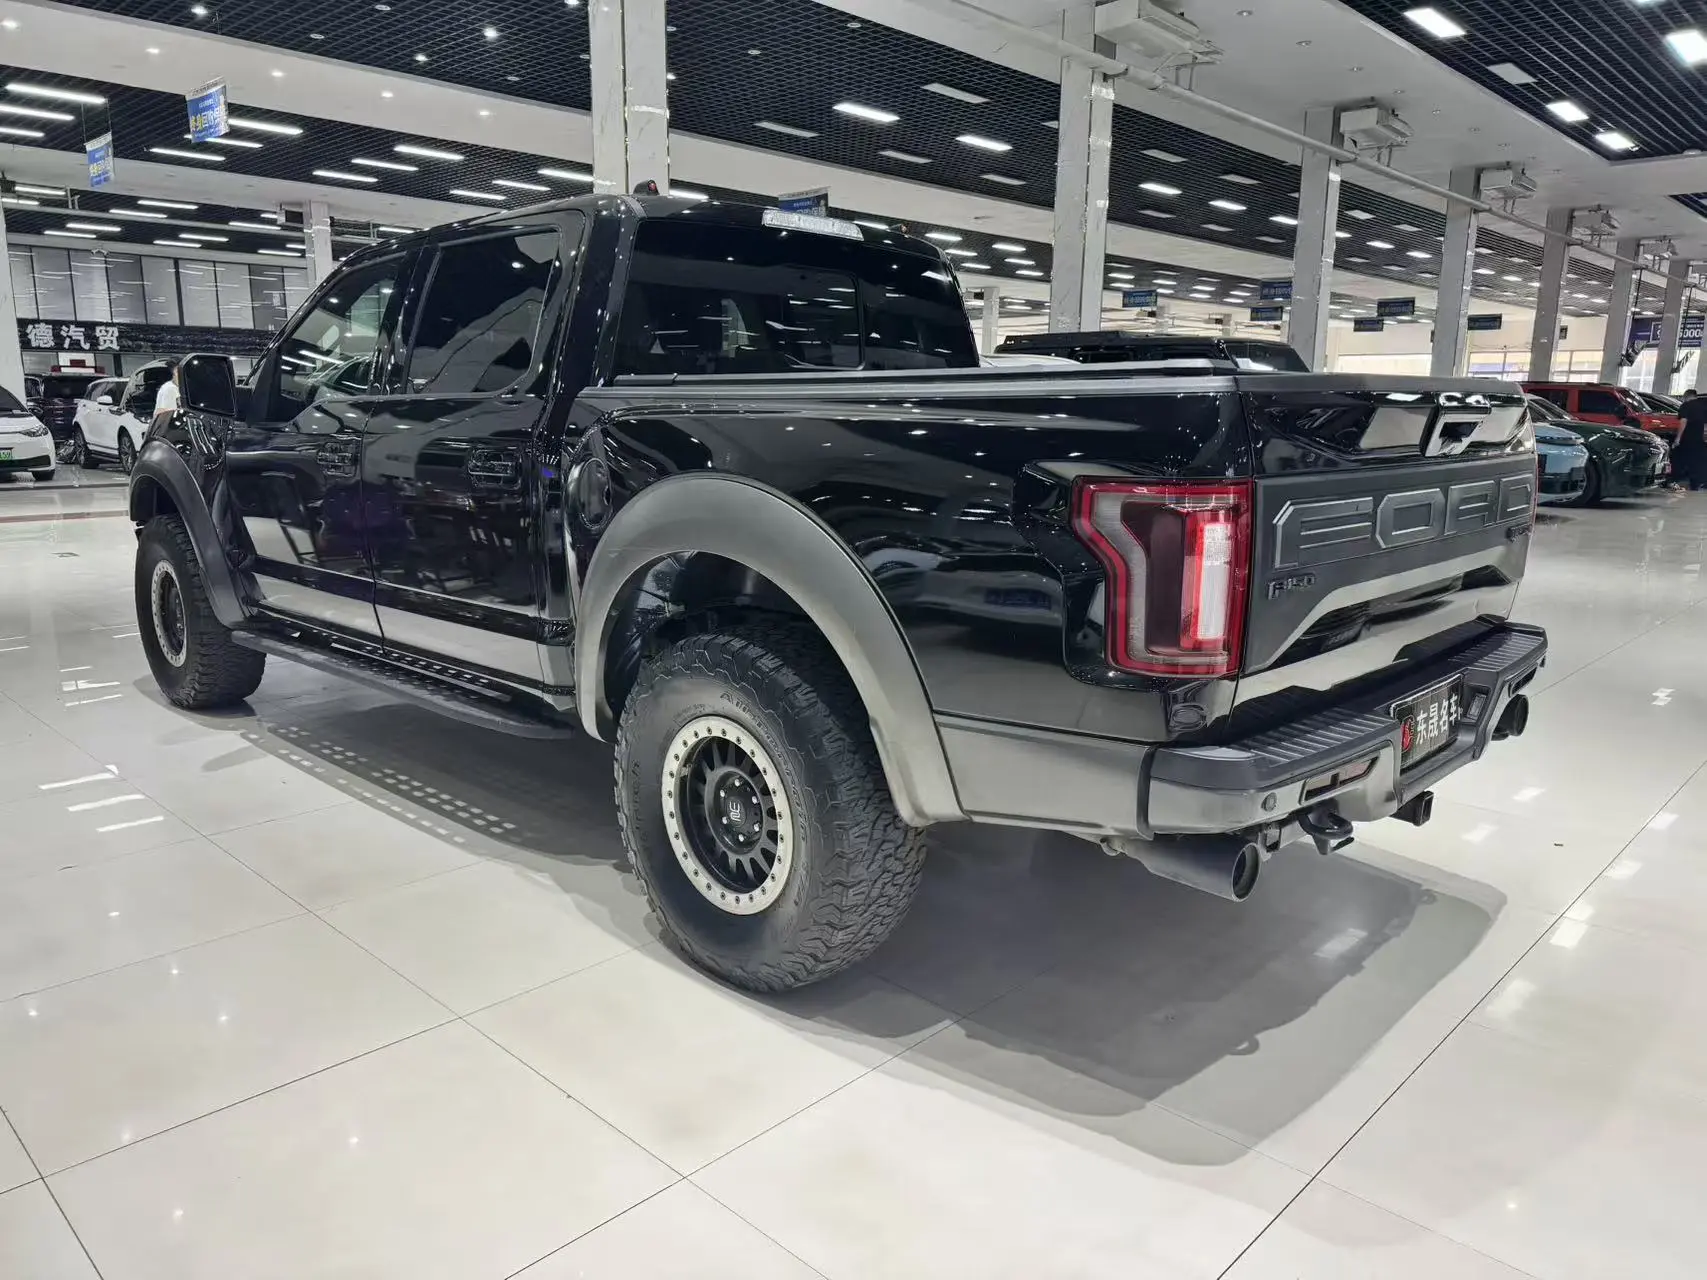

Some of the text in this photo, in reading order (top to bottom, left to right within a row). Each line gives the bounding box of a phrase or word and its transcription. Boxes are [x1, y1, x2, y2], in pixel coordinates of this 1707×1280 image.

[26, 322, 120, 351] 德汽贸
[1273, 474, 1533, 569] FORD
